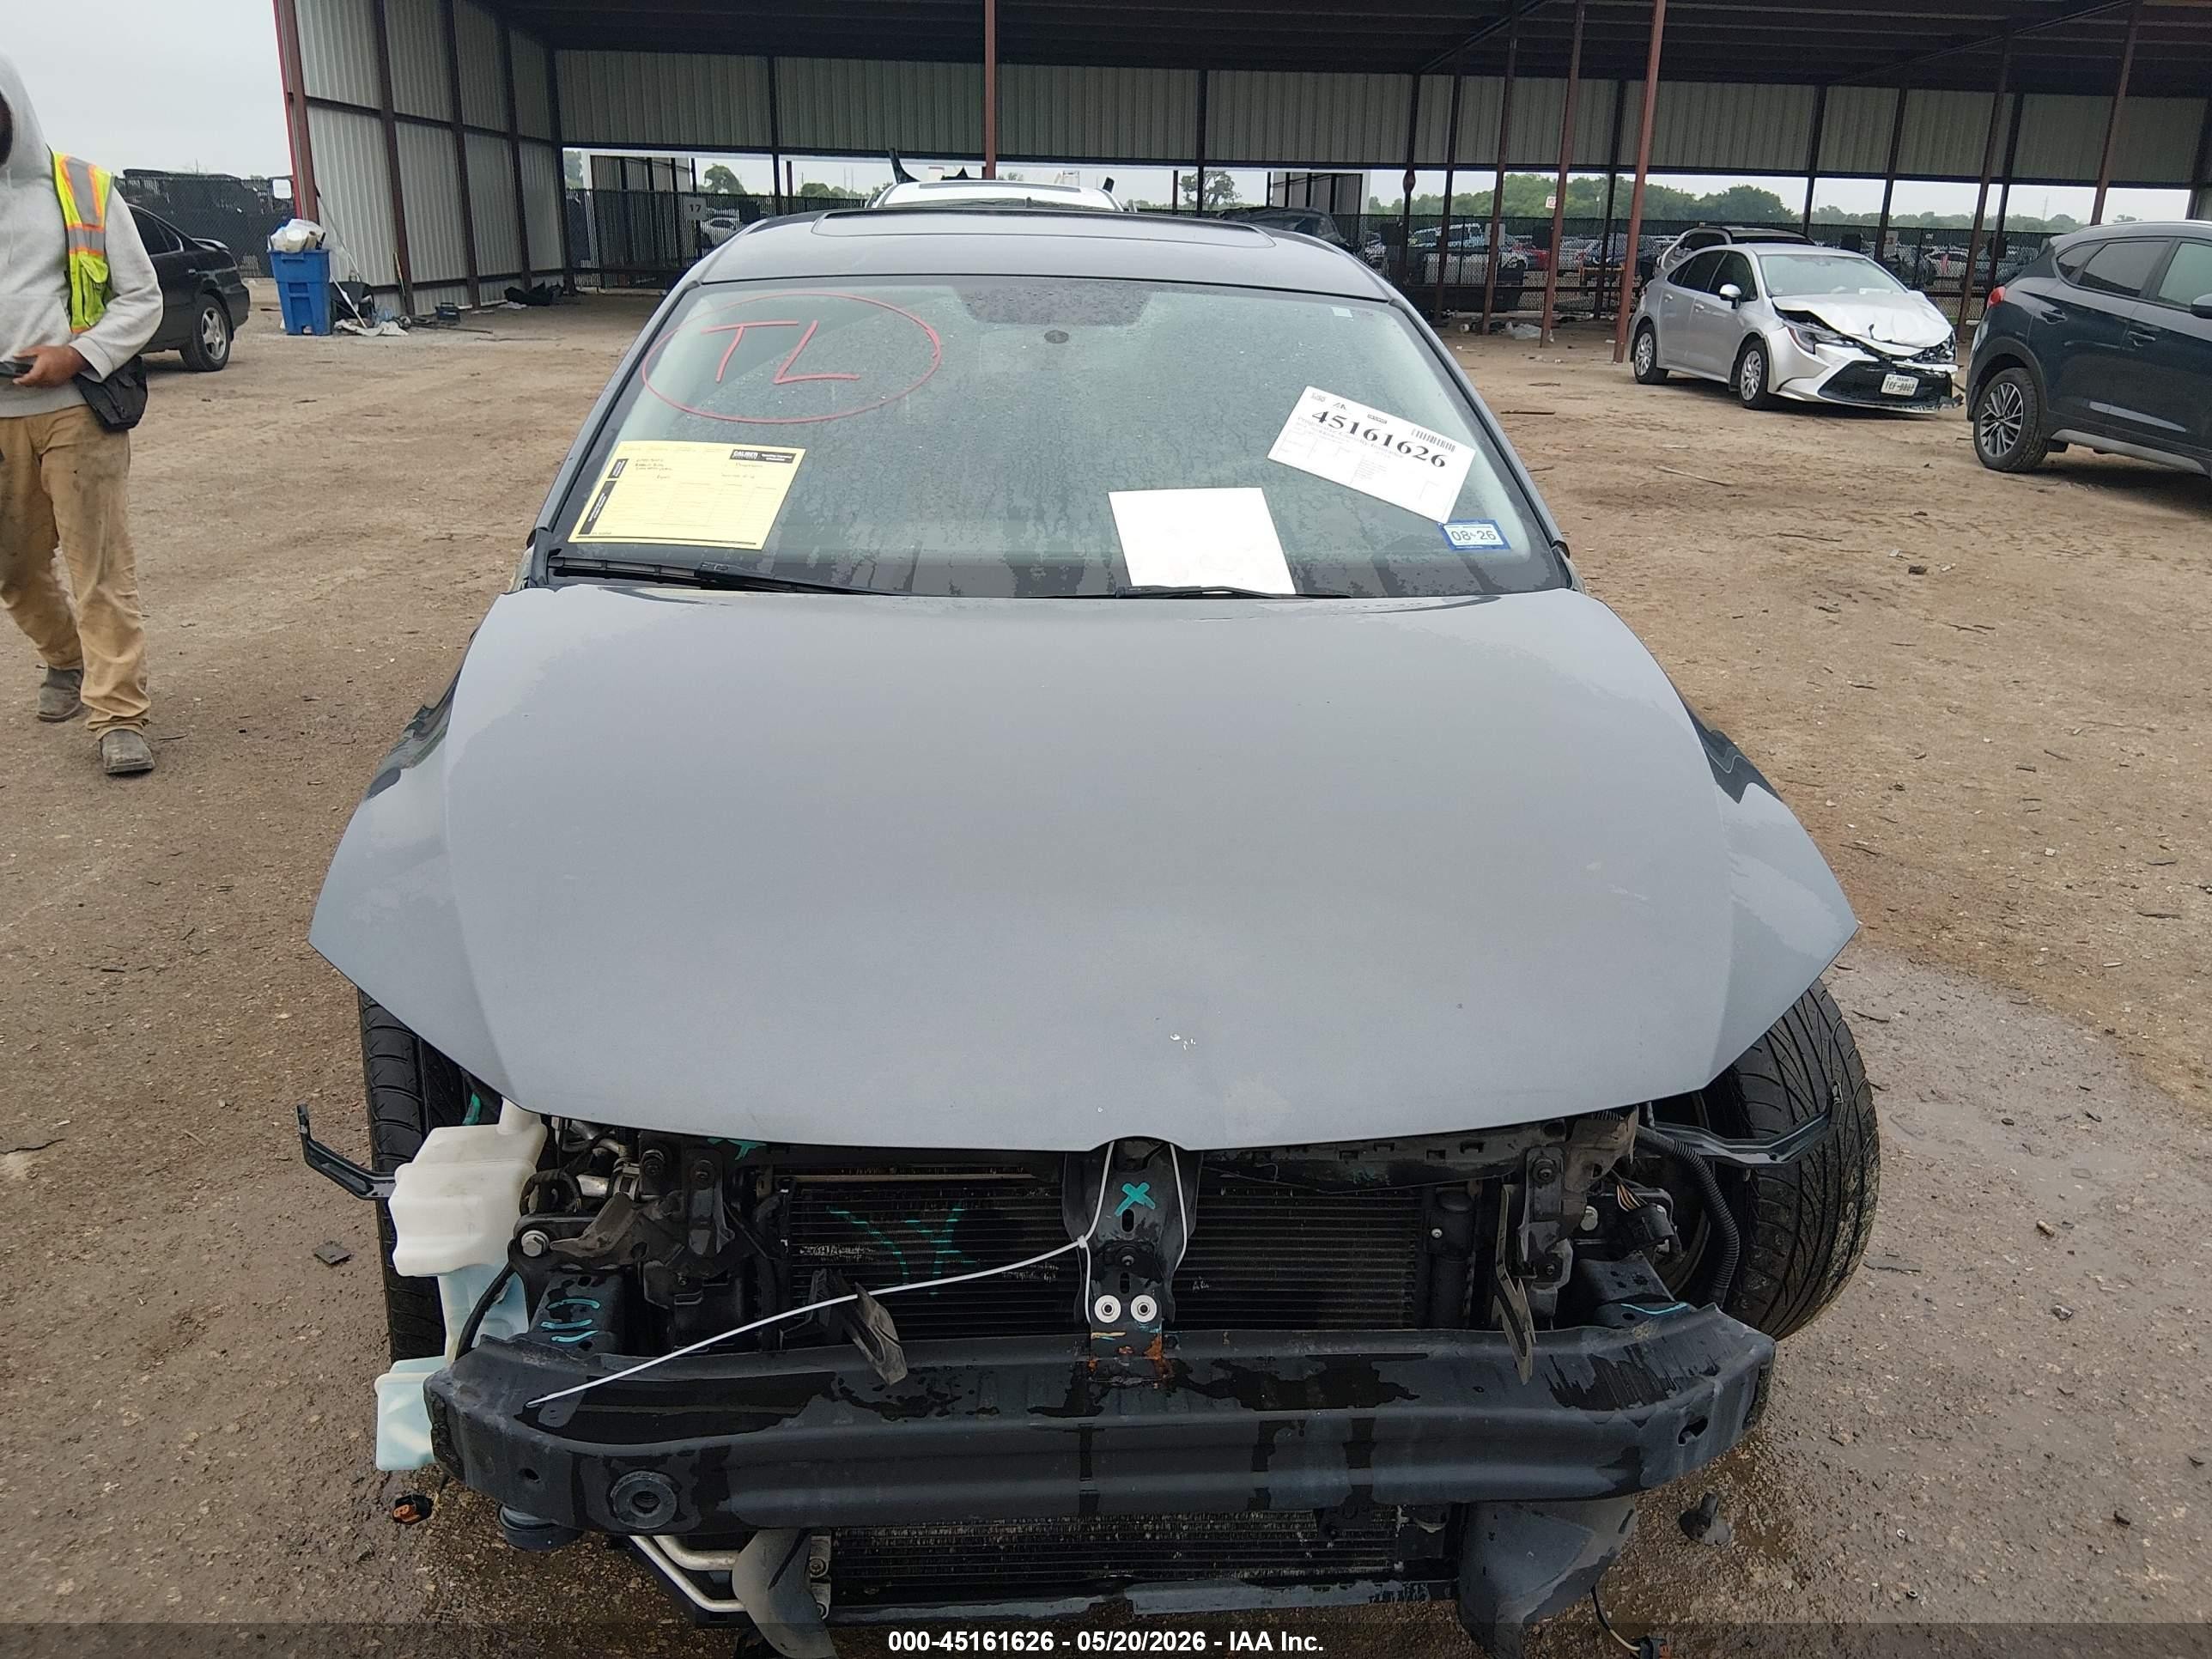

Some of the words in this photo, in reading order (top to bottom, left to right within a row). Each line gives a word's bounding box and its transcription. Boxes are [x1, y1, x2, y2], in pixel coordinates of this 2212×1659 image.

[690, 204, 702, 213] 17
[700, 319, 862, 385] TL
[1311, 410, 1446, 468] 45161626
[1450, 531, 1472, 541] 08
[1477, 530, 1497, 540] 26
